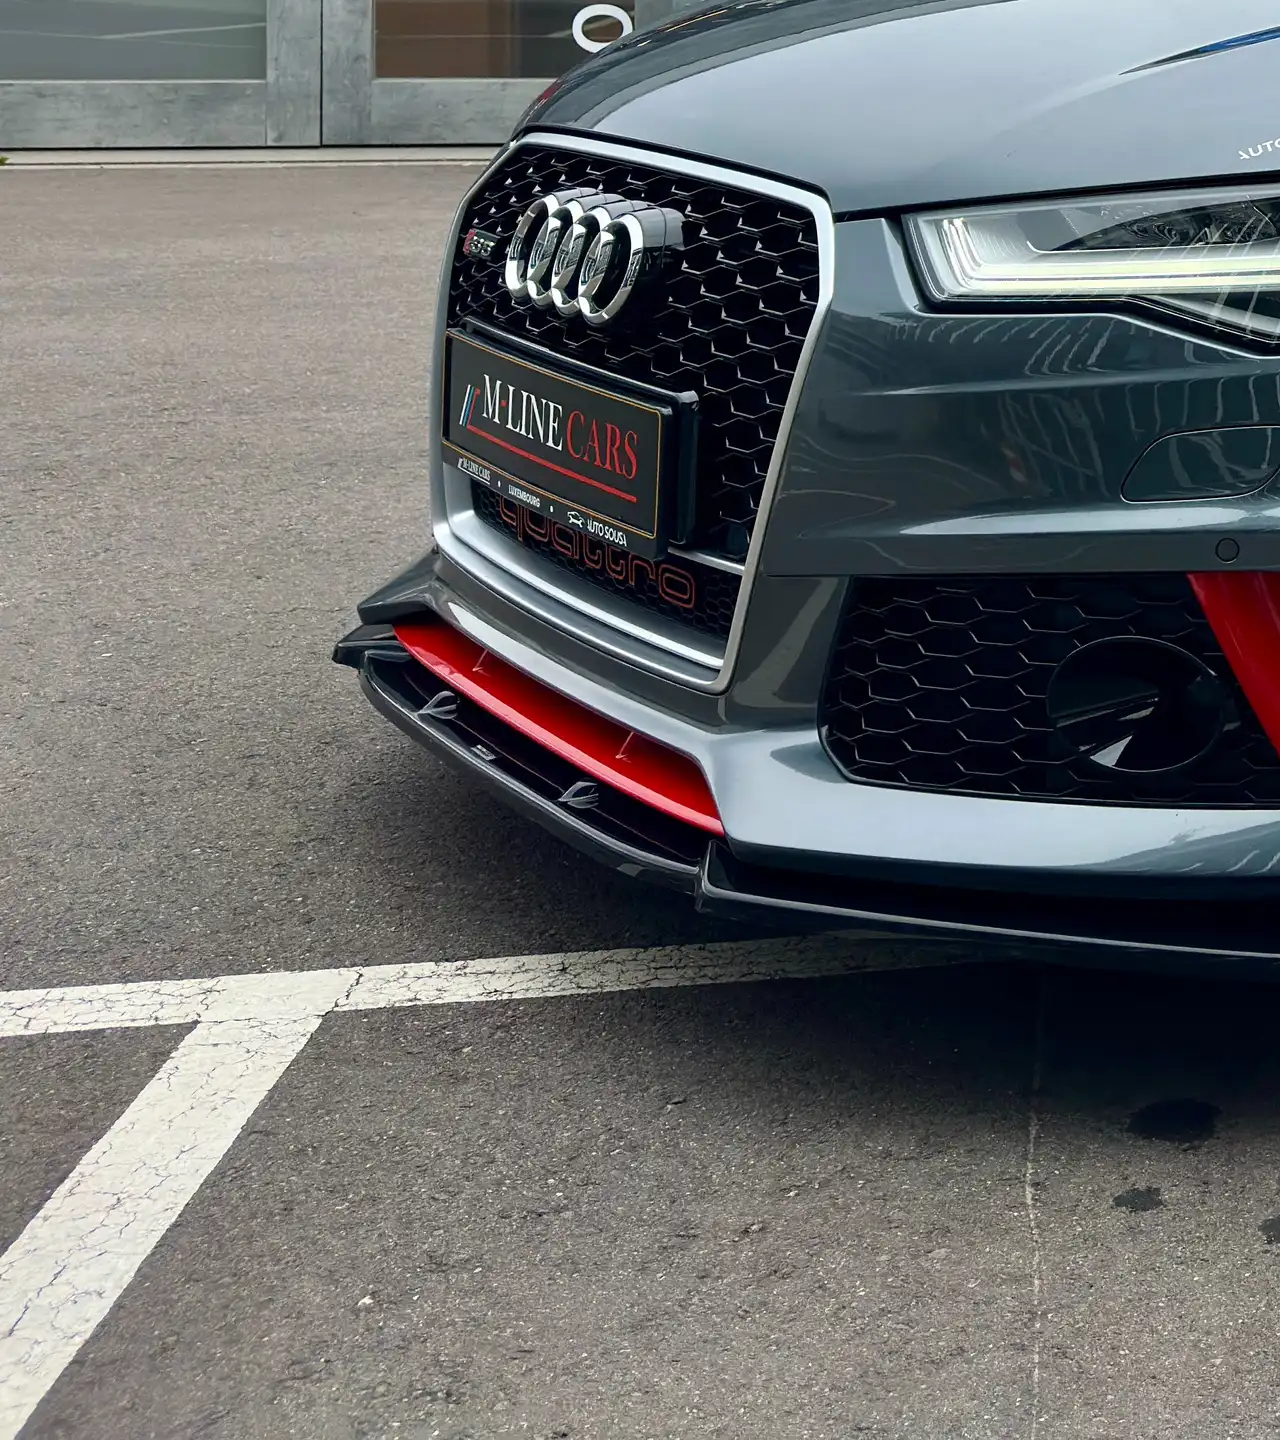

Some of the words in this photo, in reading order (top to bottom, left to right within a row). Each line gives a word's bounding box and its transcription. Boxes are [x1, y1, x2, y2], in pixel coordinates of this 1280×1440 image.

[566, 410, 638, 480] CARS
[508, 484, 540, 508] LUXEMBOURG
[586, 517, 604, 537] AUTO
[604, 524, 627, 547] SOUSA
